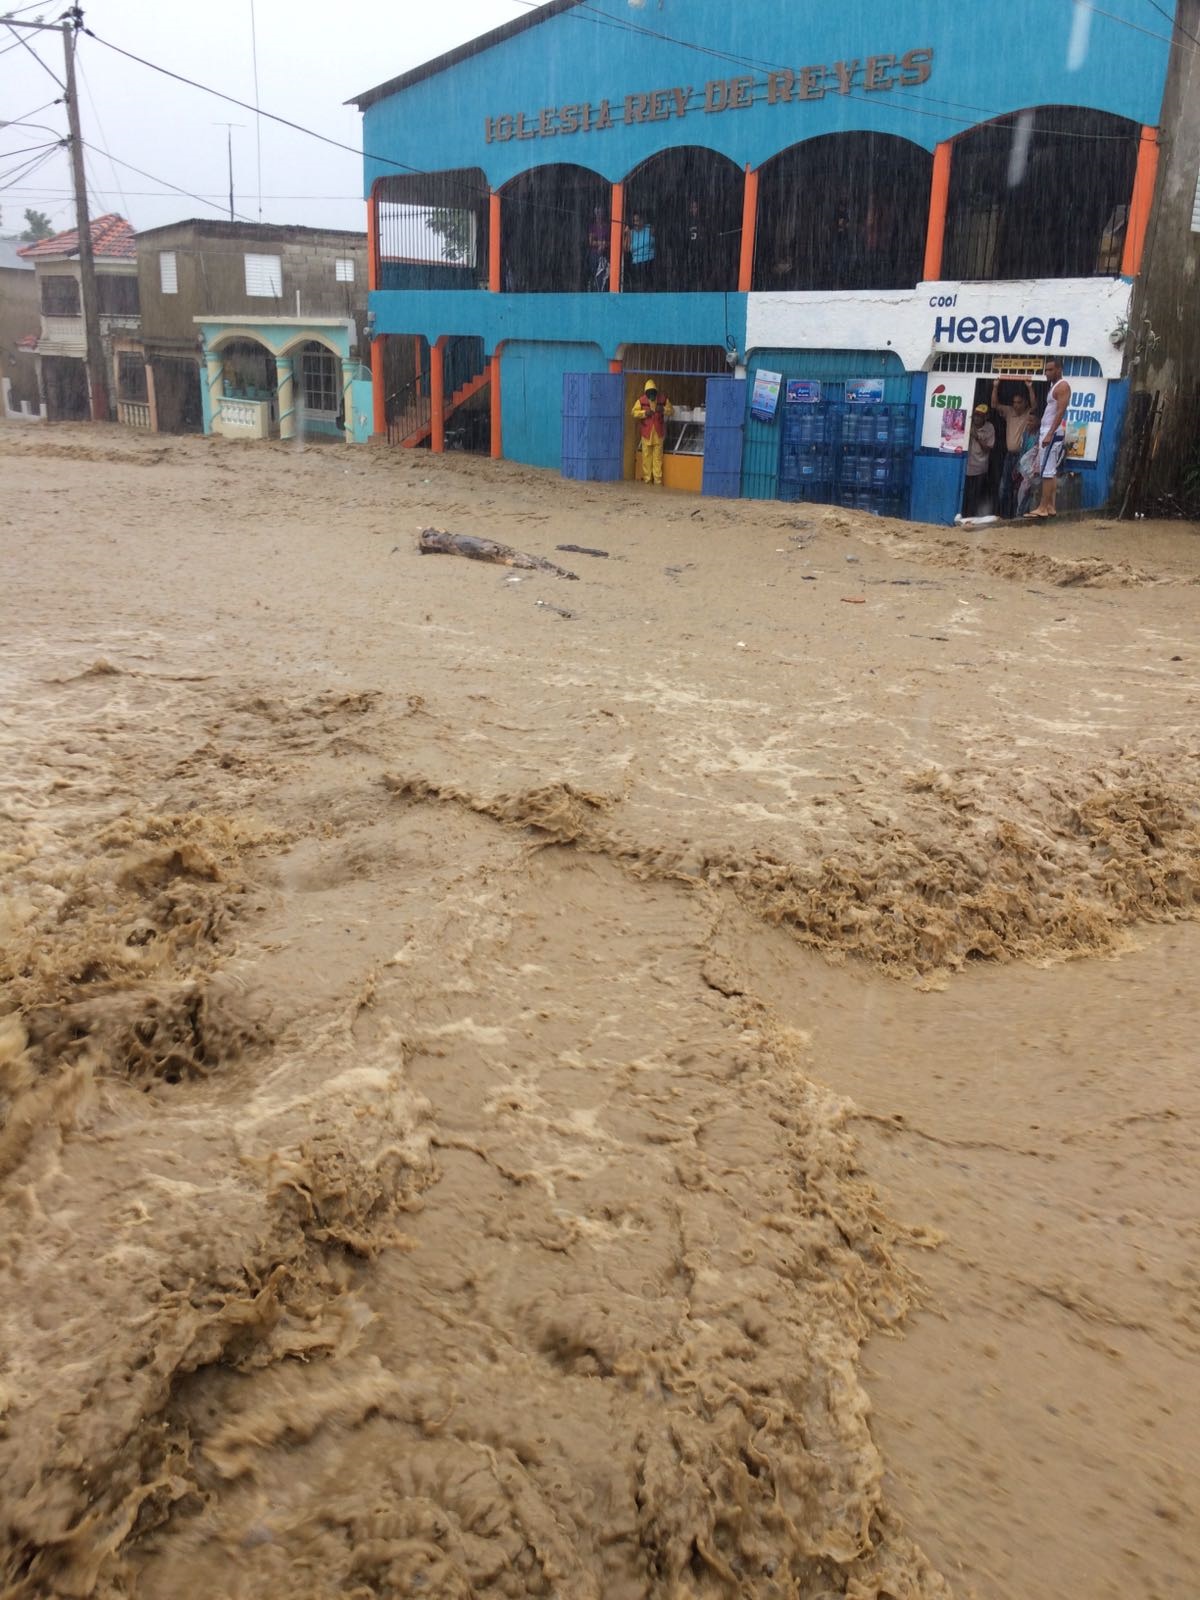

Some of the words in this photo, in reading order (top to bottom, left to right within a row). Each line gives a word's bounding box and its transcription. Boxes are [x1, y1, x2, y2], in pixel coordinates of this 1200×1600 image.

[484, 98, 614, 143] IGLESIA
[624, 85, 694, 124] REY
[704, 76, 754, 113] DE
[767, 47, 934, 106] REYES
[934, 315, 1070, 348] Heaven
[930, 385, 962, 410] ism
[1071, 391, 1096, 408] UA
